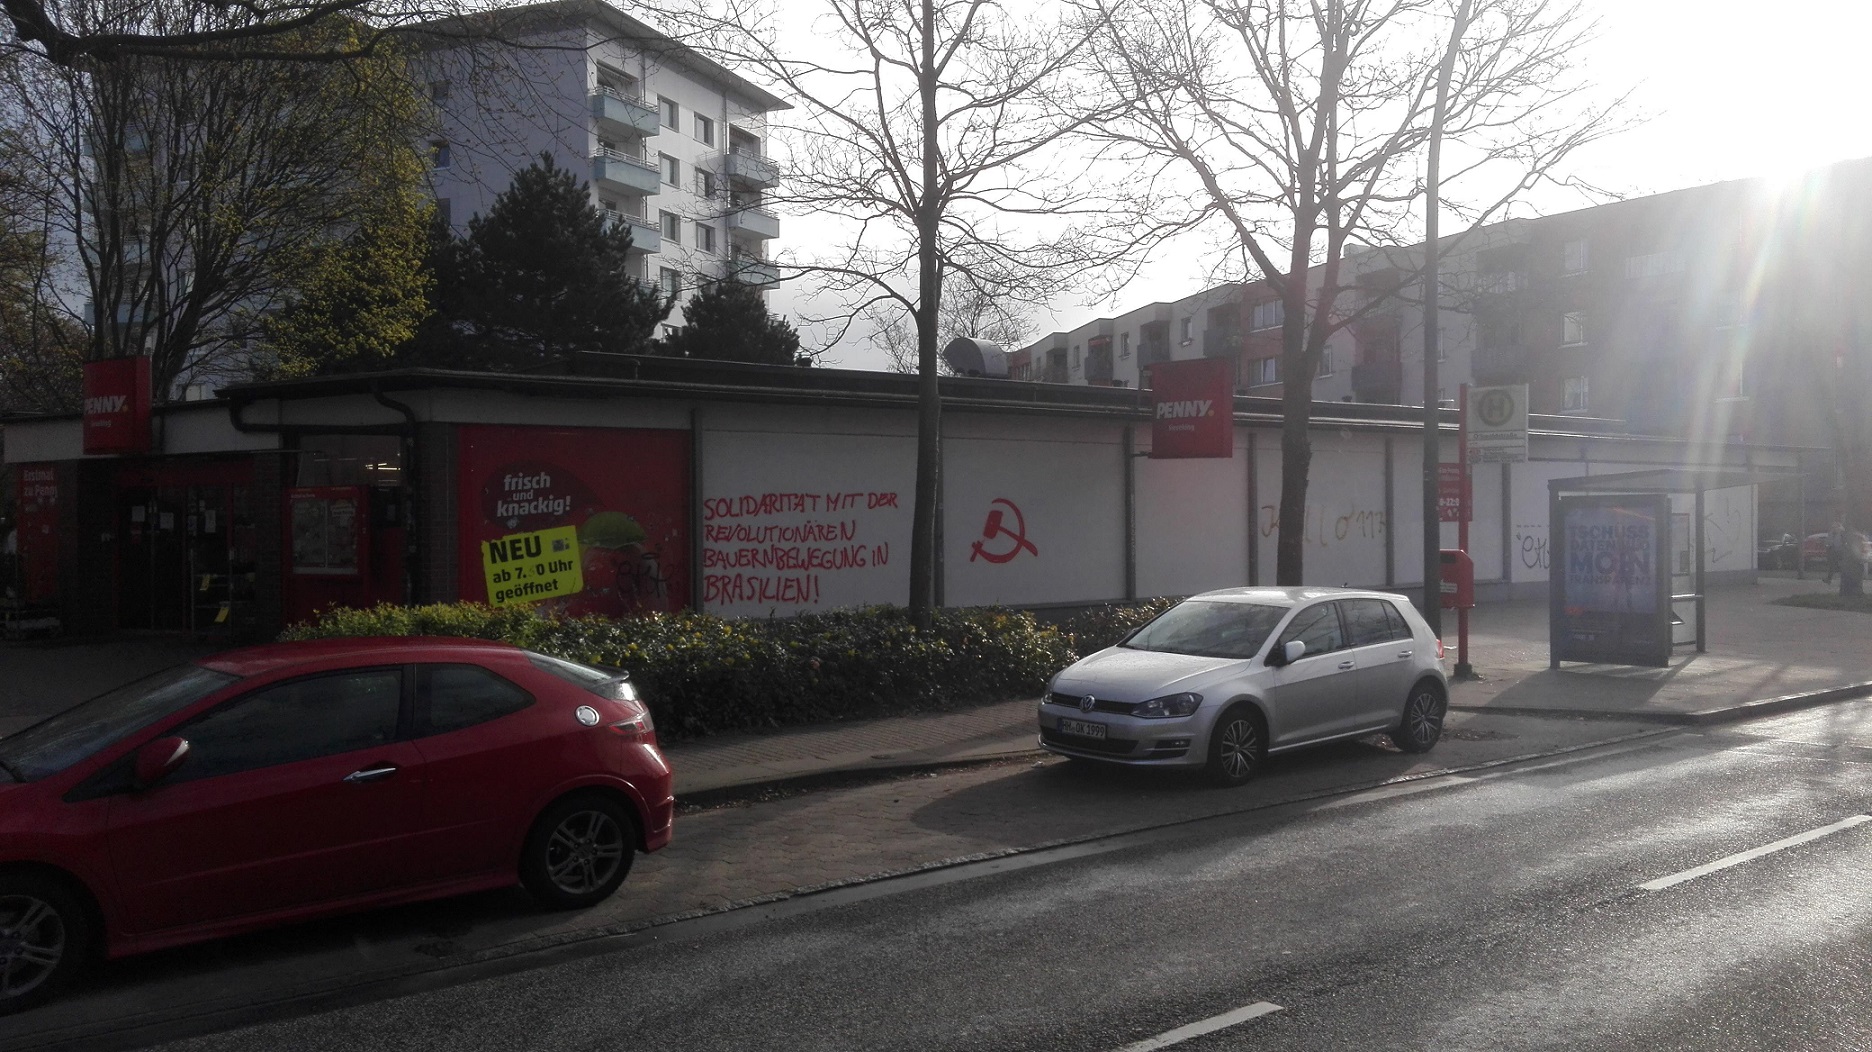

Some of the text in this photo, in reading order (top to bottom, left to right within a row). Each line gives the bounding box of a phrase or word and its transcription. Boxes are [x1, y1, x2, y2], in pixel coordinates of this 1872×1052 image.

[504, 472, 550, 491] frisch
[497, 494, 571, 517] knackig!
[513, 489, 533, 501] und
[826, 492, 863, 512] MIT
[868, 492, 898, 510] DER
[704, 519, 856, 544] REVOLUTIONÄREN
[489, 536, 542, 564] NEU
[703, 542, 889, 571] BAUERNBEWEGUNG IN
[493, 569, 511, 583] ab
[549, 559, 573, 573] Uhr
[496, 578, 559, 603] geöffnet
[703, 573, 820, 605] BRASILIEN!
